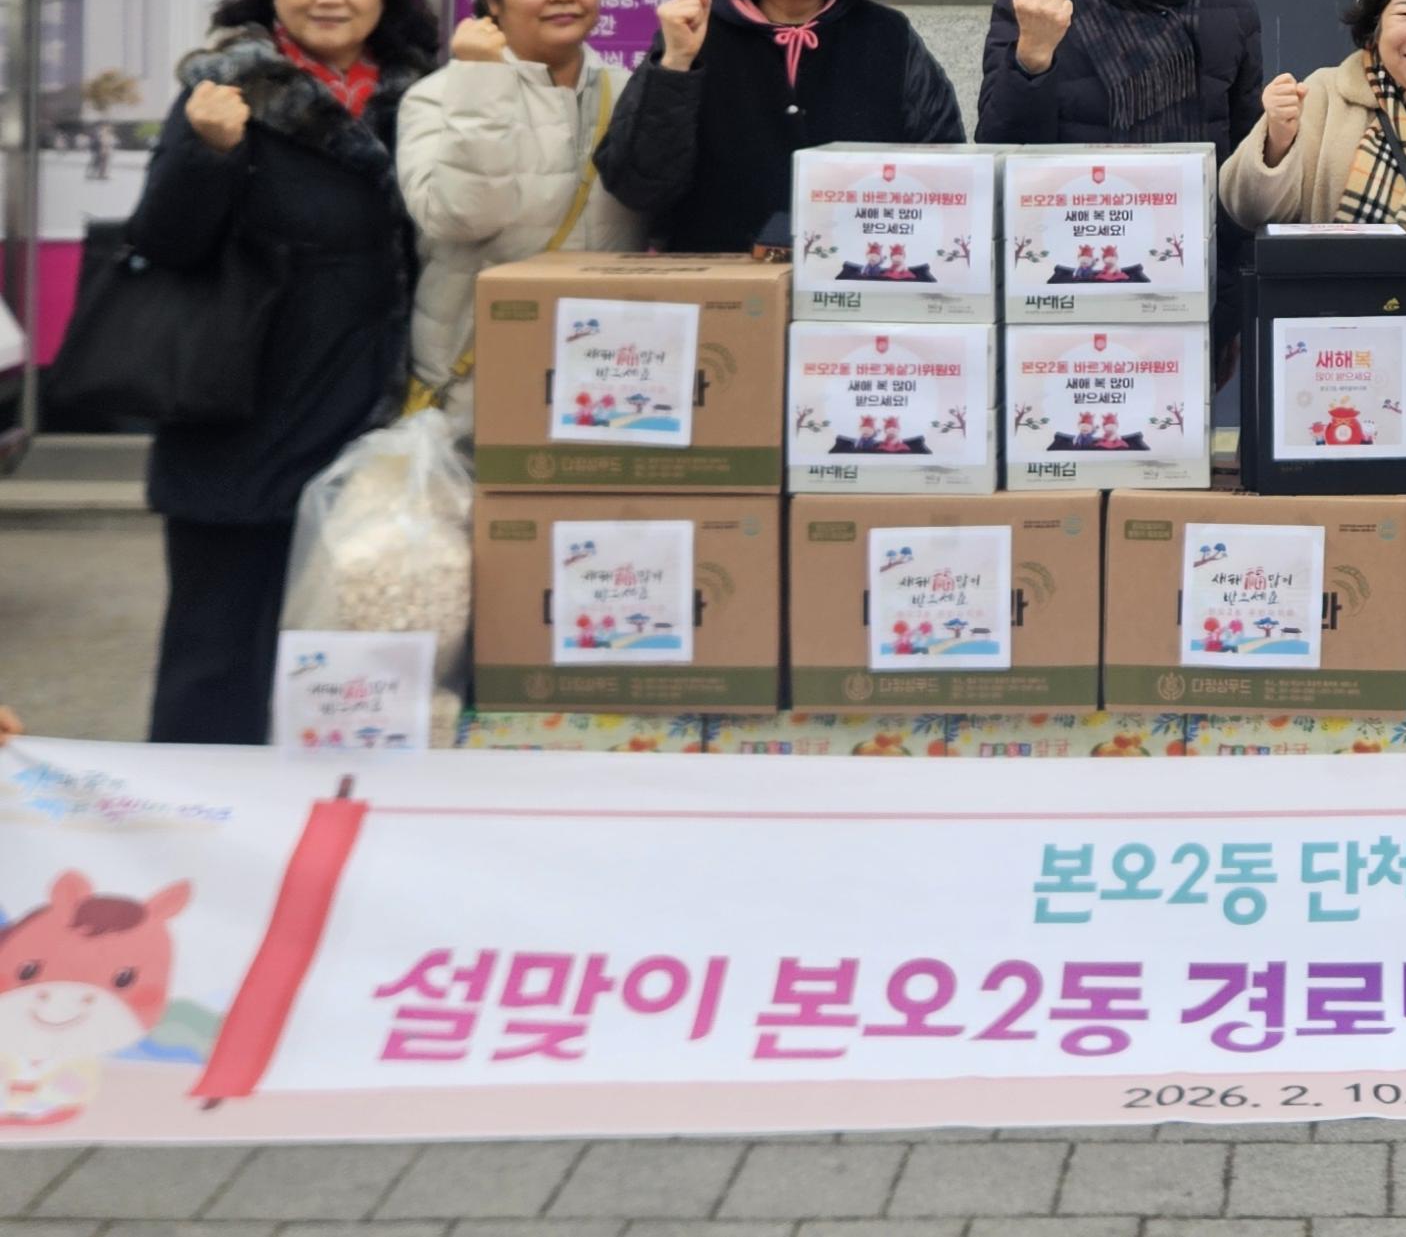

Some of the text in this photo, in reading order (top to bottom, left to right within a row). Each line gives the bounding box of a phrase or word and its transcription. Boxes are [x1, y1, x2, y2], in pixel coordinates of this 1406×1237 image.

[811, 190, 858, 204] 본오2동
[1020, 193, 1067, 207] 본오2동
[862, 222, 914, 235] 받으세요!
[1073, 225, 1125, 237] 받으세요!
[1022, 361, 1069, 375] 본오2동
[1073, 392, 1127, 405] 받으세요!
[1033, 842, 1277, 925] 본오2동
[373, 948, 729, 1062] 설맞이
[751, 954, 1149, 1061] 본오2동
[1123, 1084, 1261, 1109] 2026.
[1279, 1084, 1323, 1108] 2.
